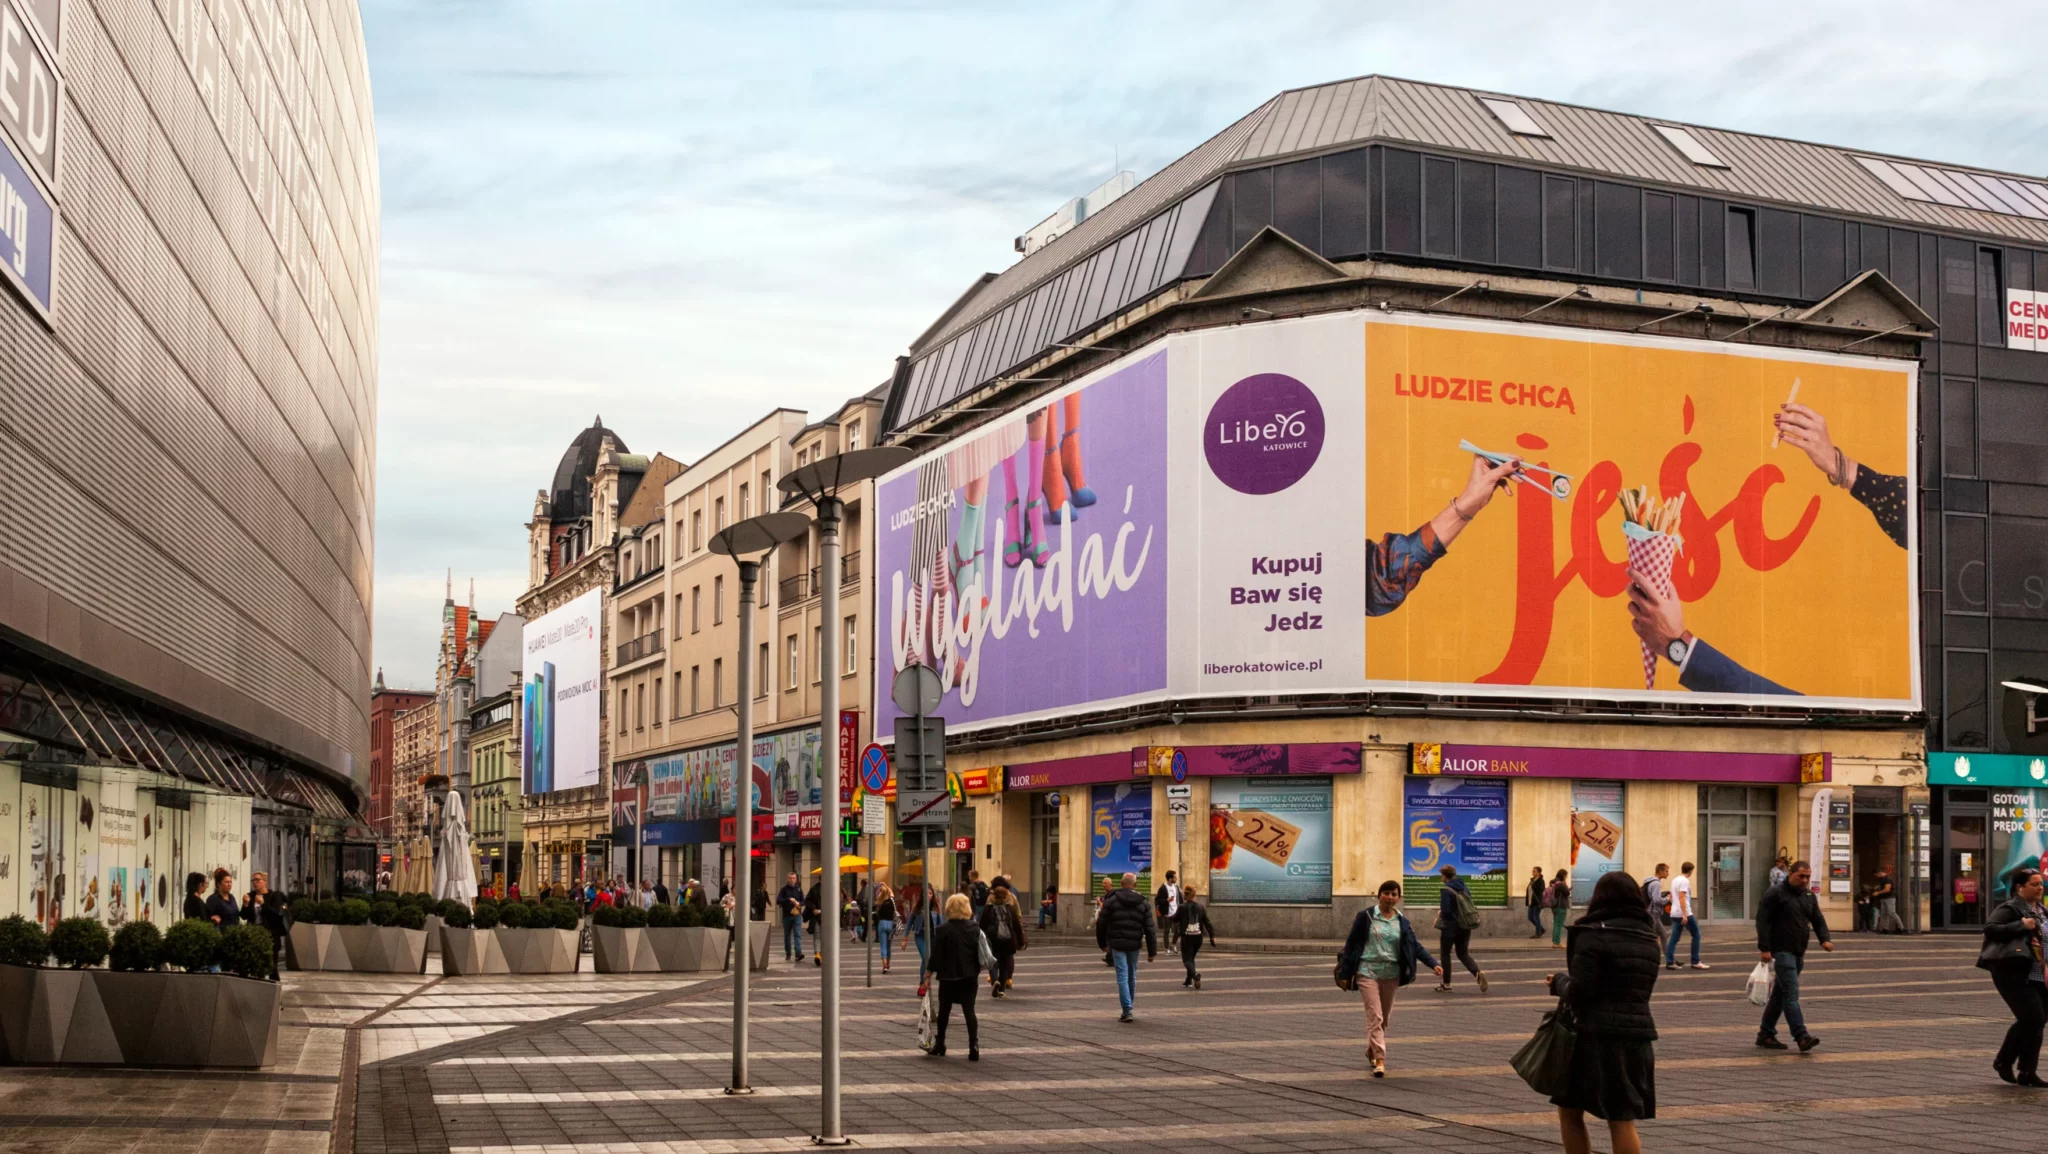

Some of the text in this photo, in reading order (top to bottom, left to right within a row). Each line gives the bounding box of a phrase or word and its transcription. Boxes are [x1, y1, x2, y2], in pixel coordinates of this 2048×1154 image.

[1394, 373, 1576, 416] LUDZIE CHCĄ
[1263, 441, 1308, 452] KATOWICE
[890, 488, 957, 532] LUDZIE CHCĄ
[1251, 552, 1323, 577] Kupuj
[1230, 582, 1323, 605] Baw się
[1264, 611, 1323, 632] Jedz
[1203, 658, 1323, 675] liberokatowice.pl
[840, 727, 848, 788] APTEKA
[1442, 758, 1529, 773] ALIOR BANK
[1009, 774, 1050, 788] ALIOR BANK
[912, 798, 935, 808] Drog
[901, 809, 949, 819] weętrzna
[1993, 808, 2007, 818] NA
[1243, 817, 1290, 858] 2,7%
[1584, 819, 1616, 852] 2,7%
[545, 843, 582, 854] KANTOR
